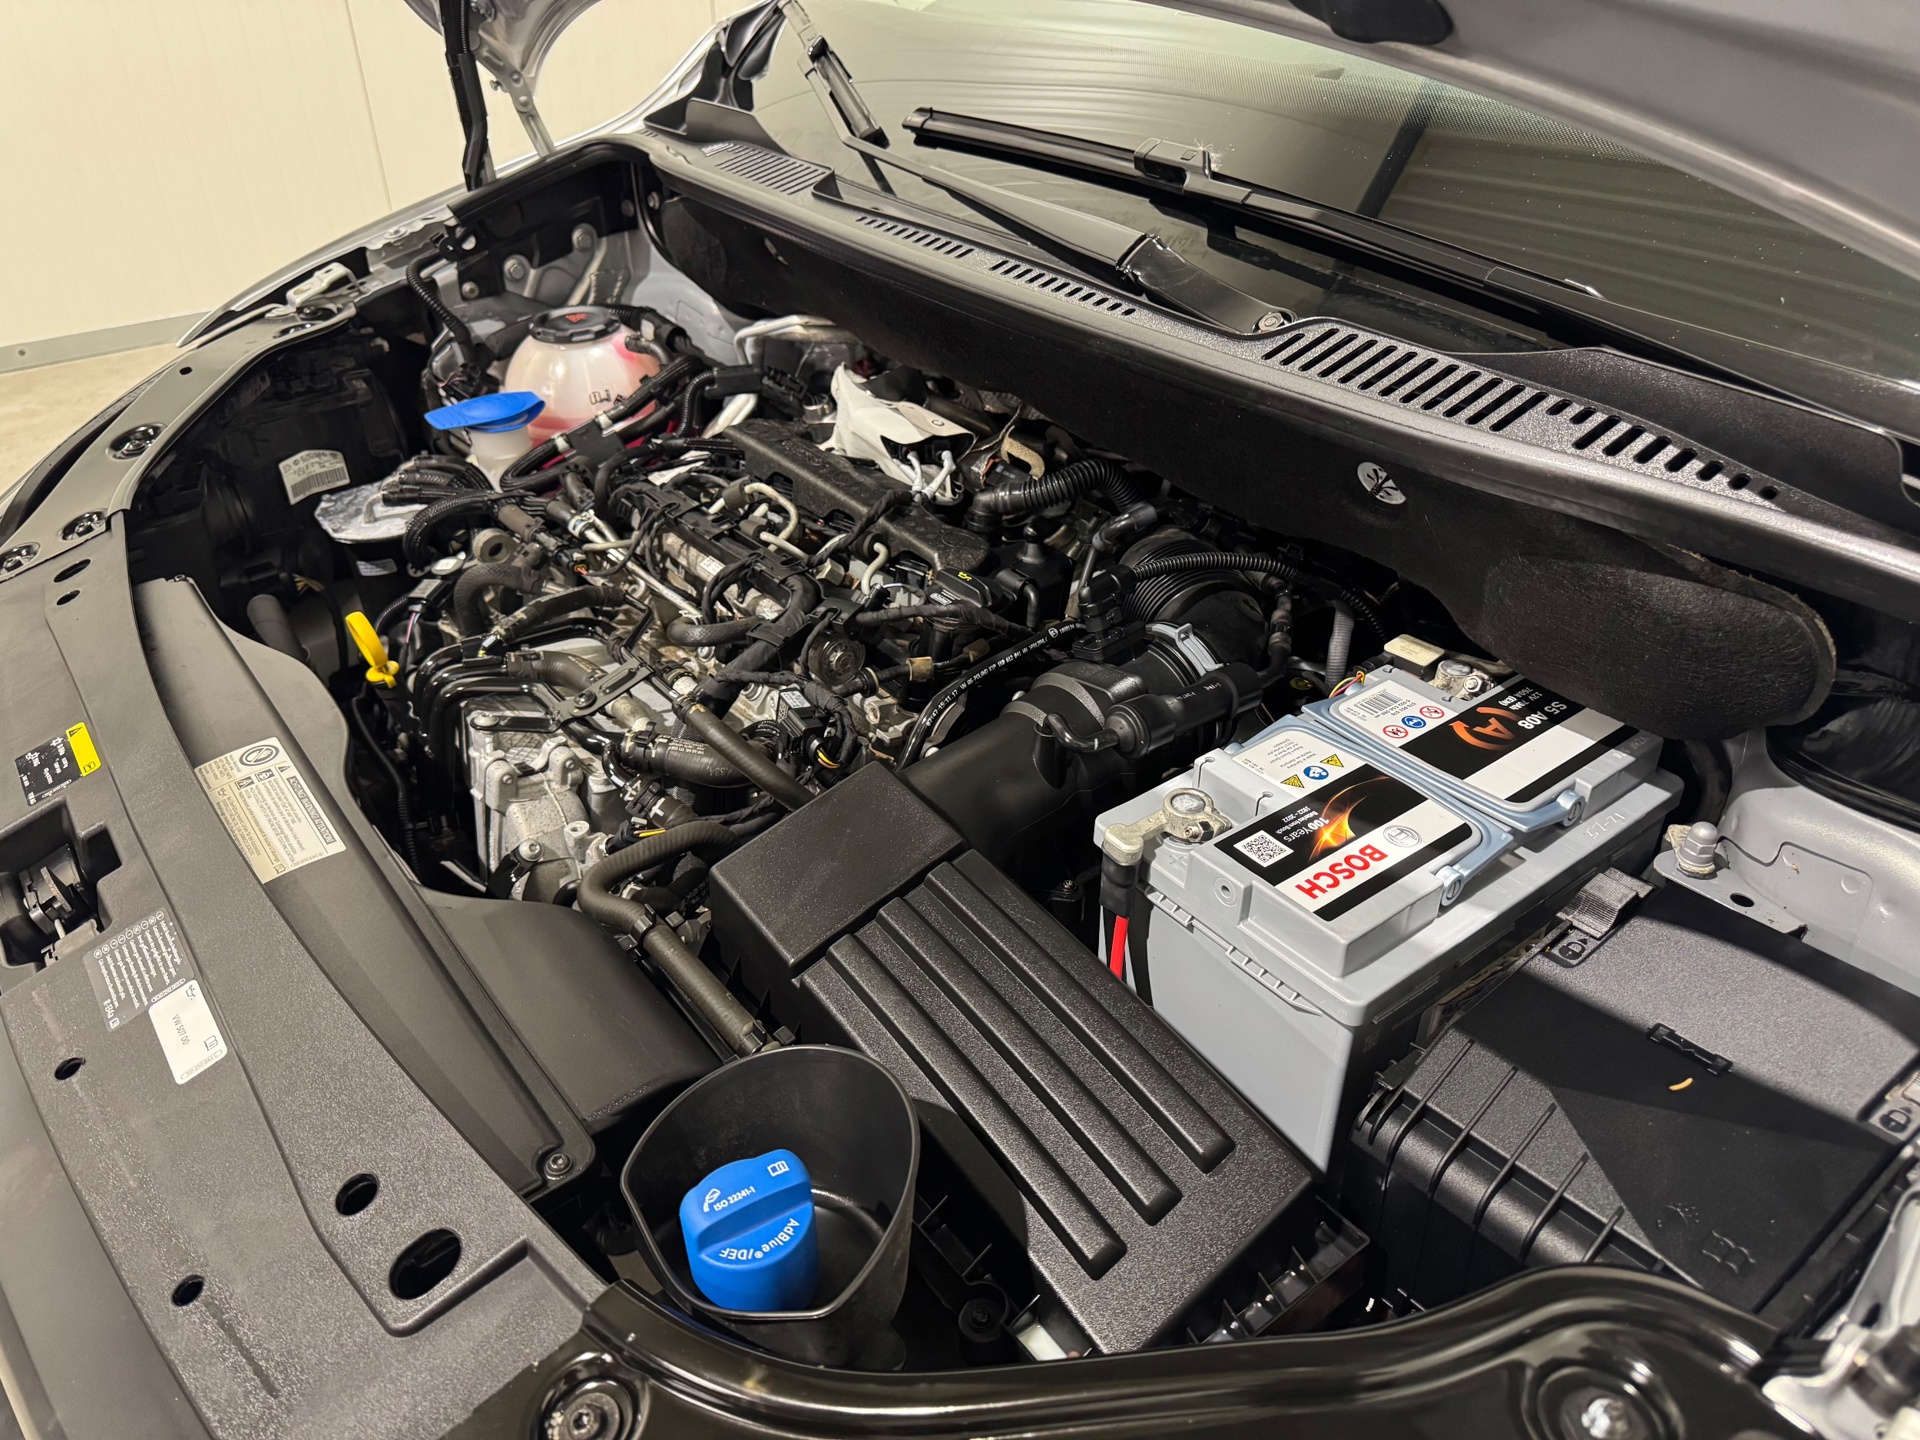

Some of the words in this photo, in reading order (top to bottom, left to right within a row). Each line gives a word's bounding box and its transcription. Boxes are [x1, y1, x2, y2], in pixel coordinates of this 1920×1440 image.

[1528, 691, 1543, 702] 12V
[1544, 701, 1568, 715] S5
[1517, 711, 1550, 730] A08
[1295, 844, 1389, 899] BOSCH
[170, 1012, 182, 1027] VW
[175, 1023, 187, 1038] 507
[713, 1198, 729, 1212] ISO
[729, 1186, 756, 1205] 22241-1
